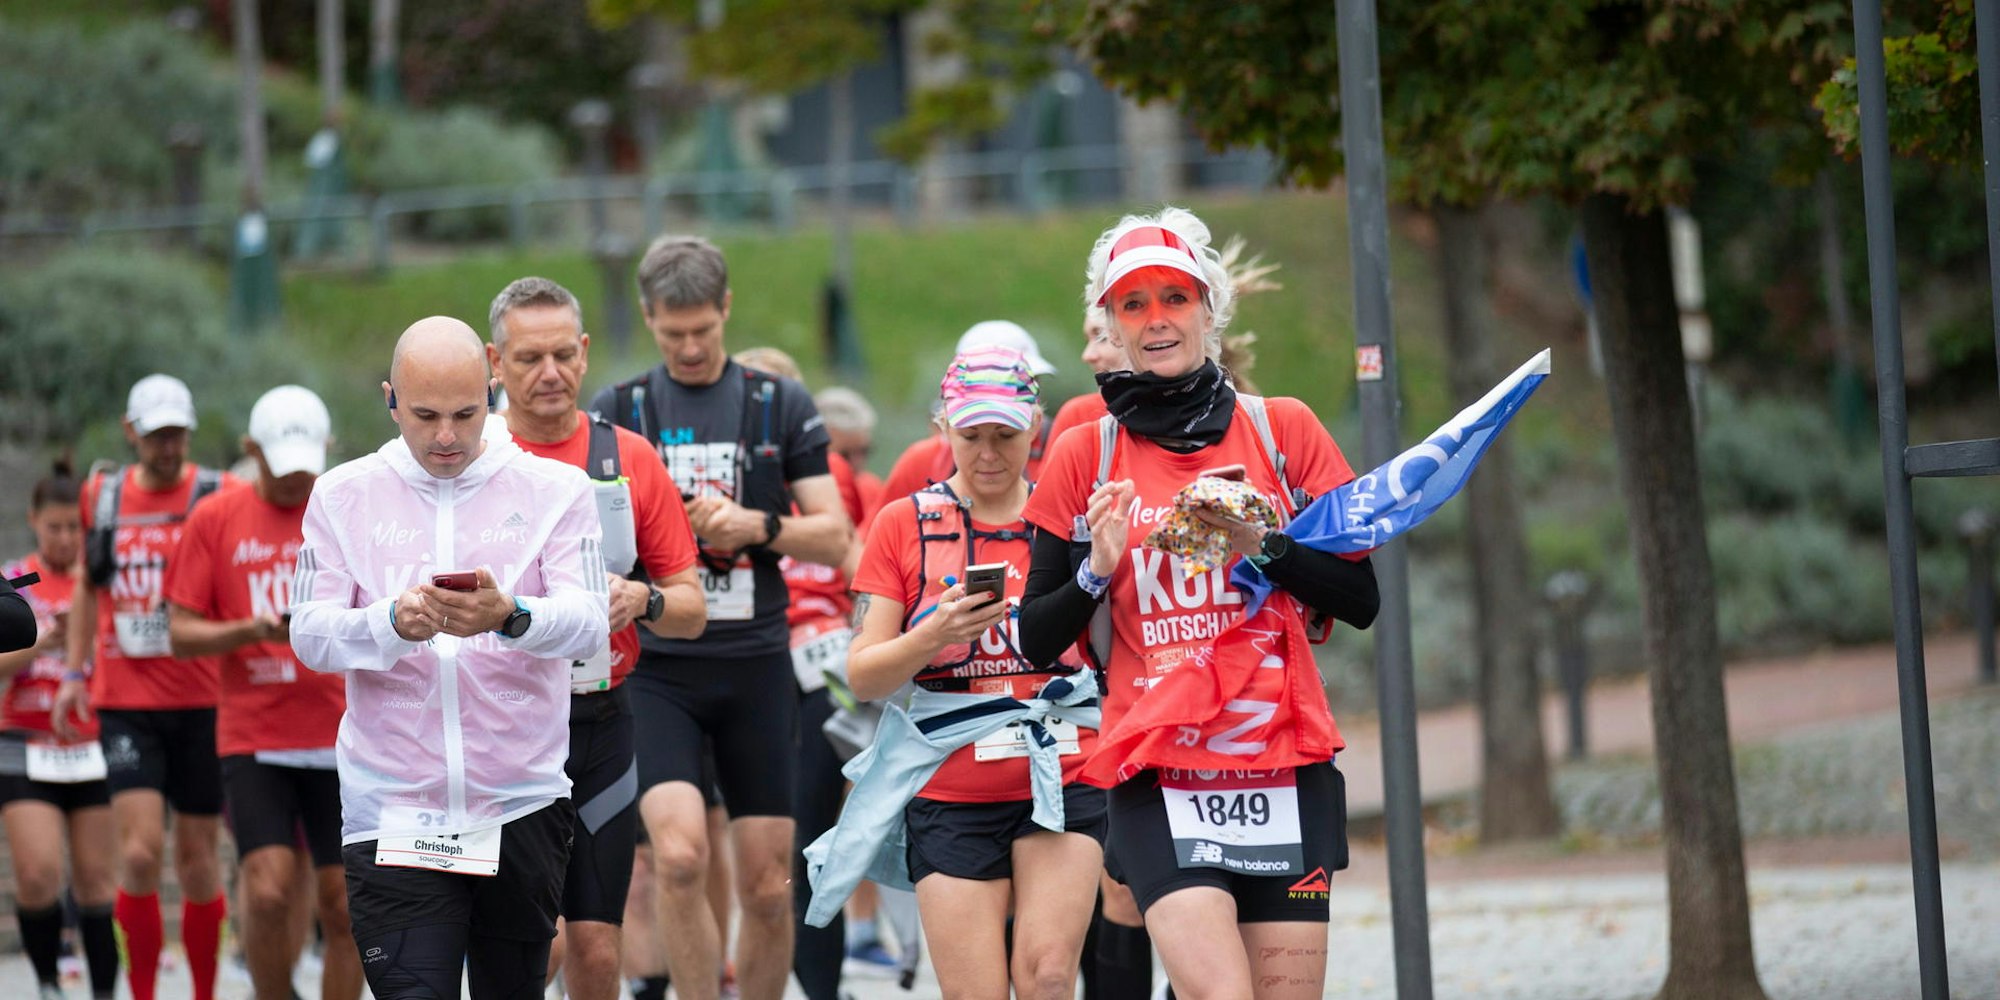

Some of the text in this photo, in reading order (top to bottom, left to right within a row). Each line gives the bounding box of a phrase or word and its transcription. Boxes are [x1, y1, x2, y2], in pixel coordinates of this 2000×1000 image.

[374, 520, 526, 547] Mer eins
[1188, 792, 1271, 827] 1849
[414, 839, 464, 856] Christoph
[418, 855, 449, 865] saucony
[1224, 857, 1291, 871] new balance
[1288, 891, 1317, 900] NIKE
